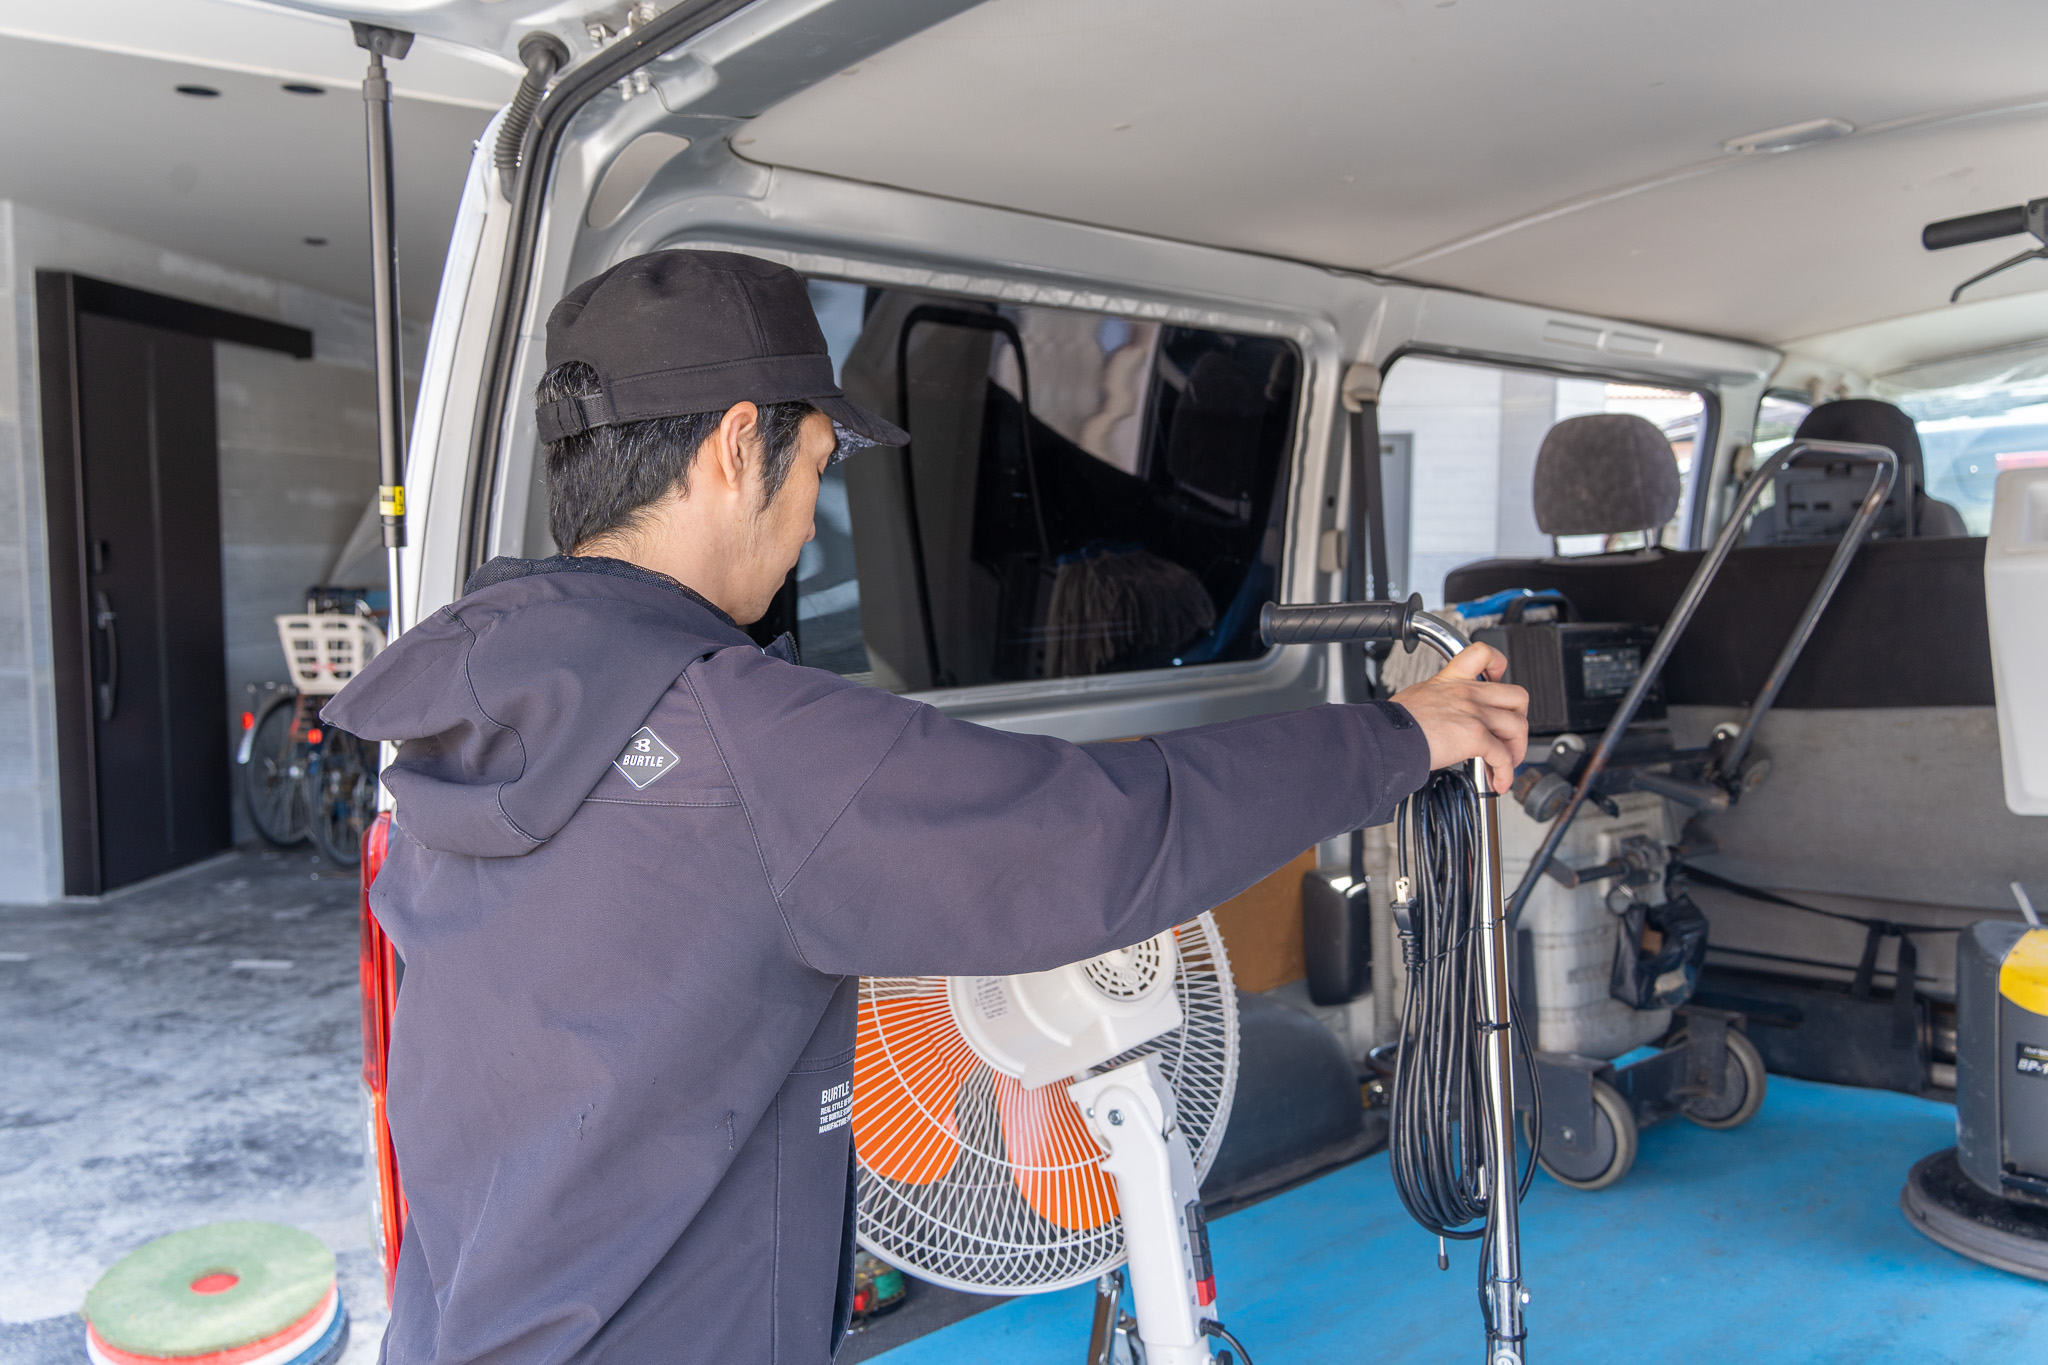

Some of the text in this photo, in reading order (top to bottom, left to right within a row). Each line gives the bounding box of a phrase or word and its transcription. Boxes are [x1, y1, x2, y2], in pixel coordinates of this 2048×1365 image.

[622, 754, 664, 768] BURTLE
[821, 1080, 850, 1105] BURTLE
[831, 1100, 844, 1112] STYLE
[820, 1115, 829, 1125] THE
